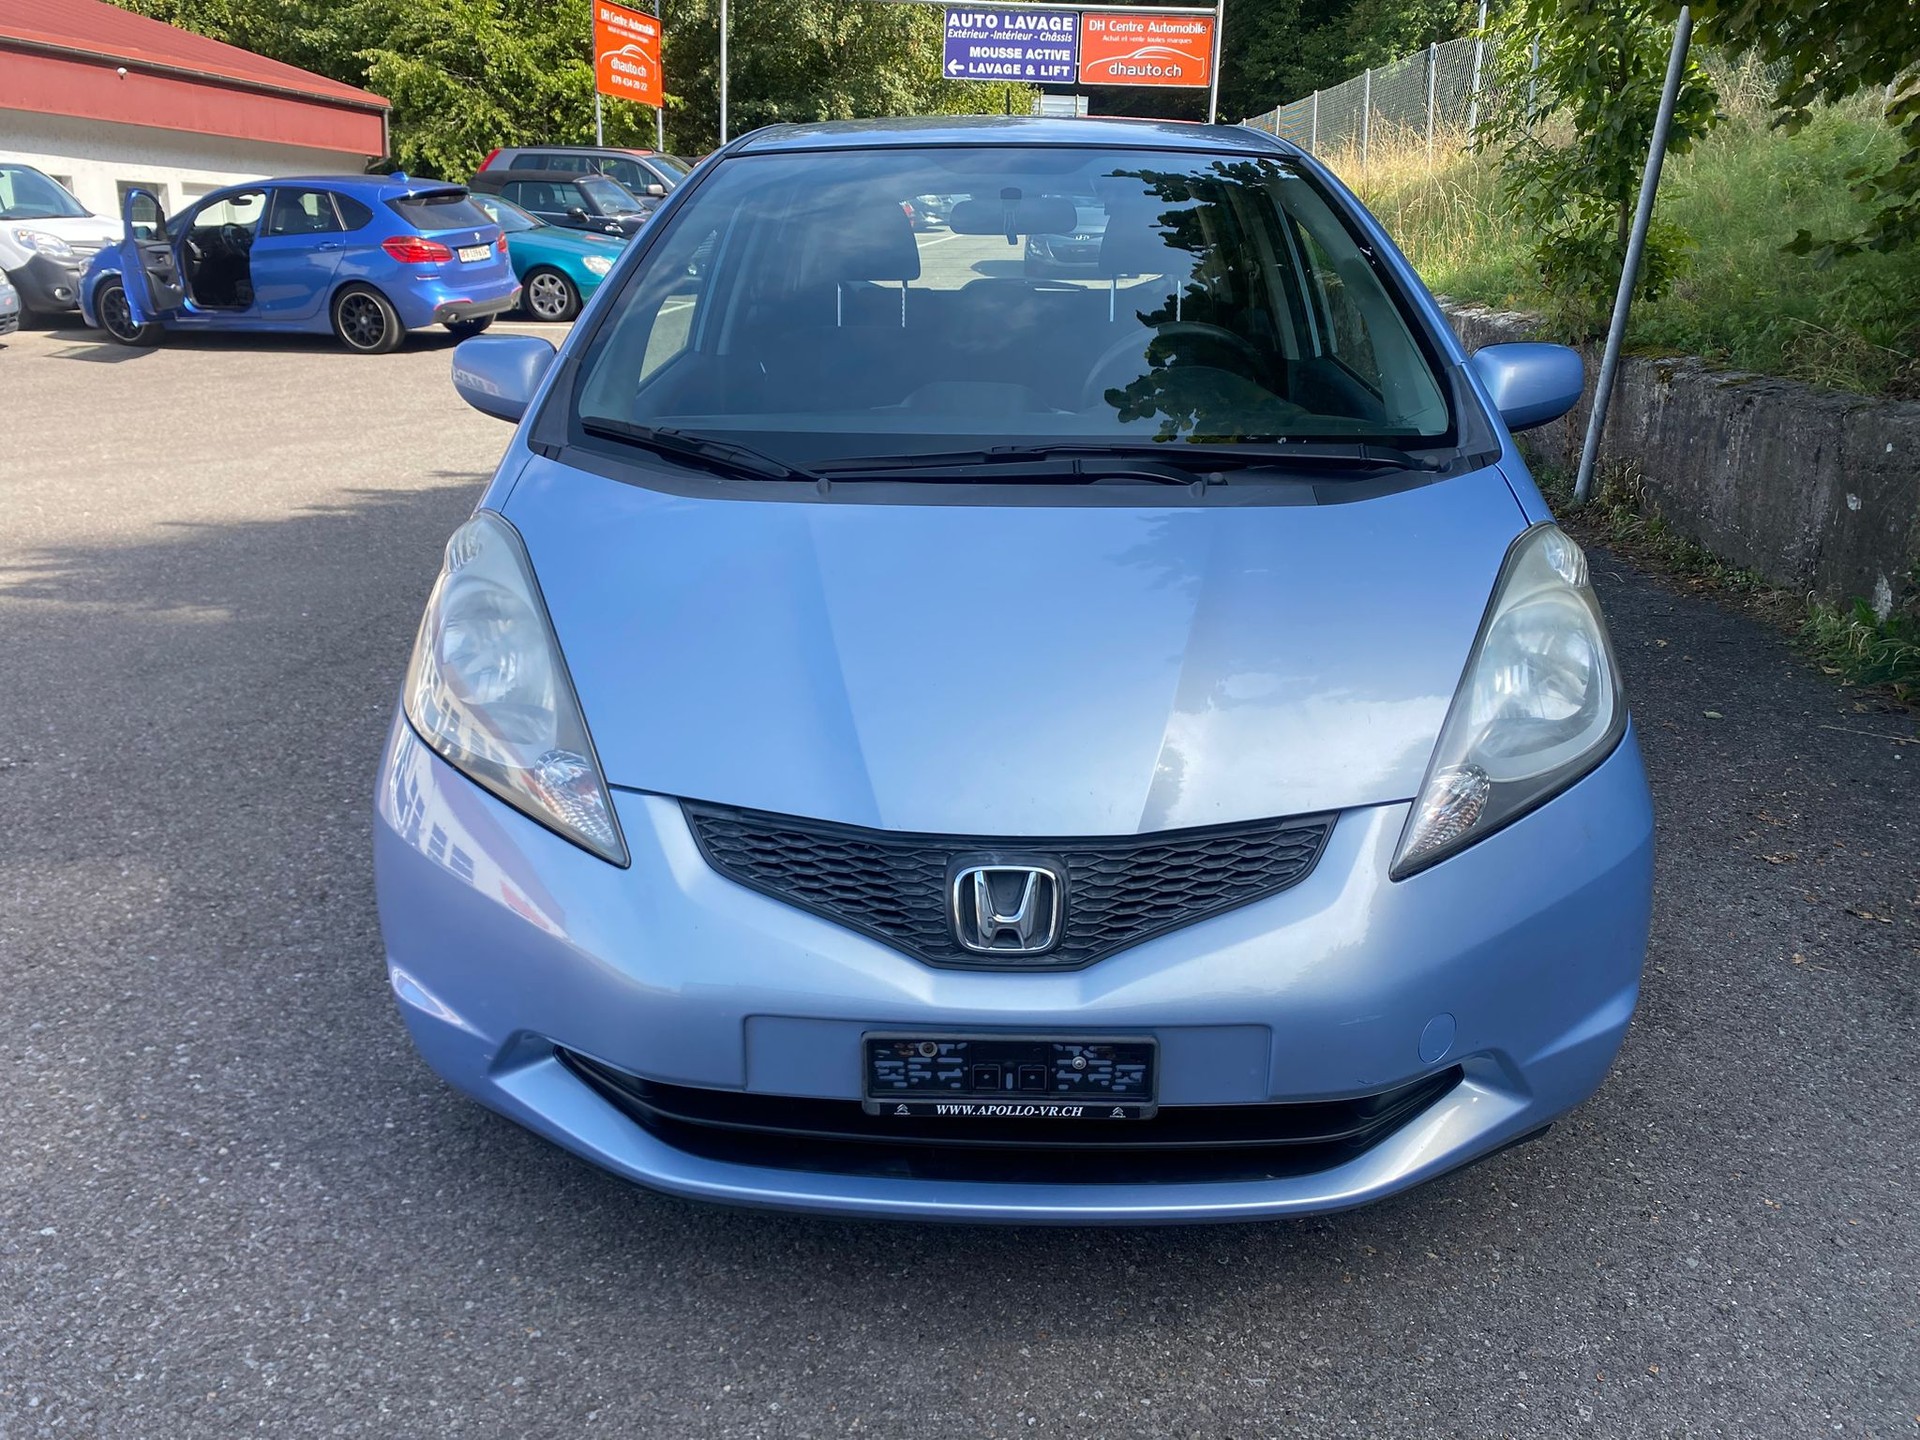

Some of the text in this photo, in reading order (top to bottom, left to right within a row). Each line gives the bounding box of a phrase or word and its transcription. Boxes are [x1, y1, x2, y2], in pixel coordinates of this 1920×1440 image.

[948, 13, 1073, 31] AUTO LAVAGE
[1089, 20, 1207, 34] DH Centre Automobile
[947, 29, 988, 39] Extérieur
[969, 46, 1071, 61] MOUSSE ACTIVE
[969, 62, 1070, 76] LAVAGE & LIFT
[1108, 62, 1182, 77] dhauto.ch
[936, 1103, 1084, 1118] WWW.APOLLO-VR.CH
